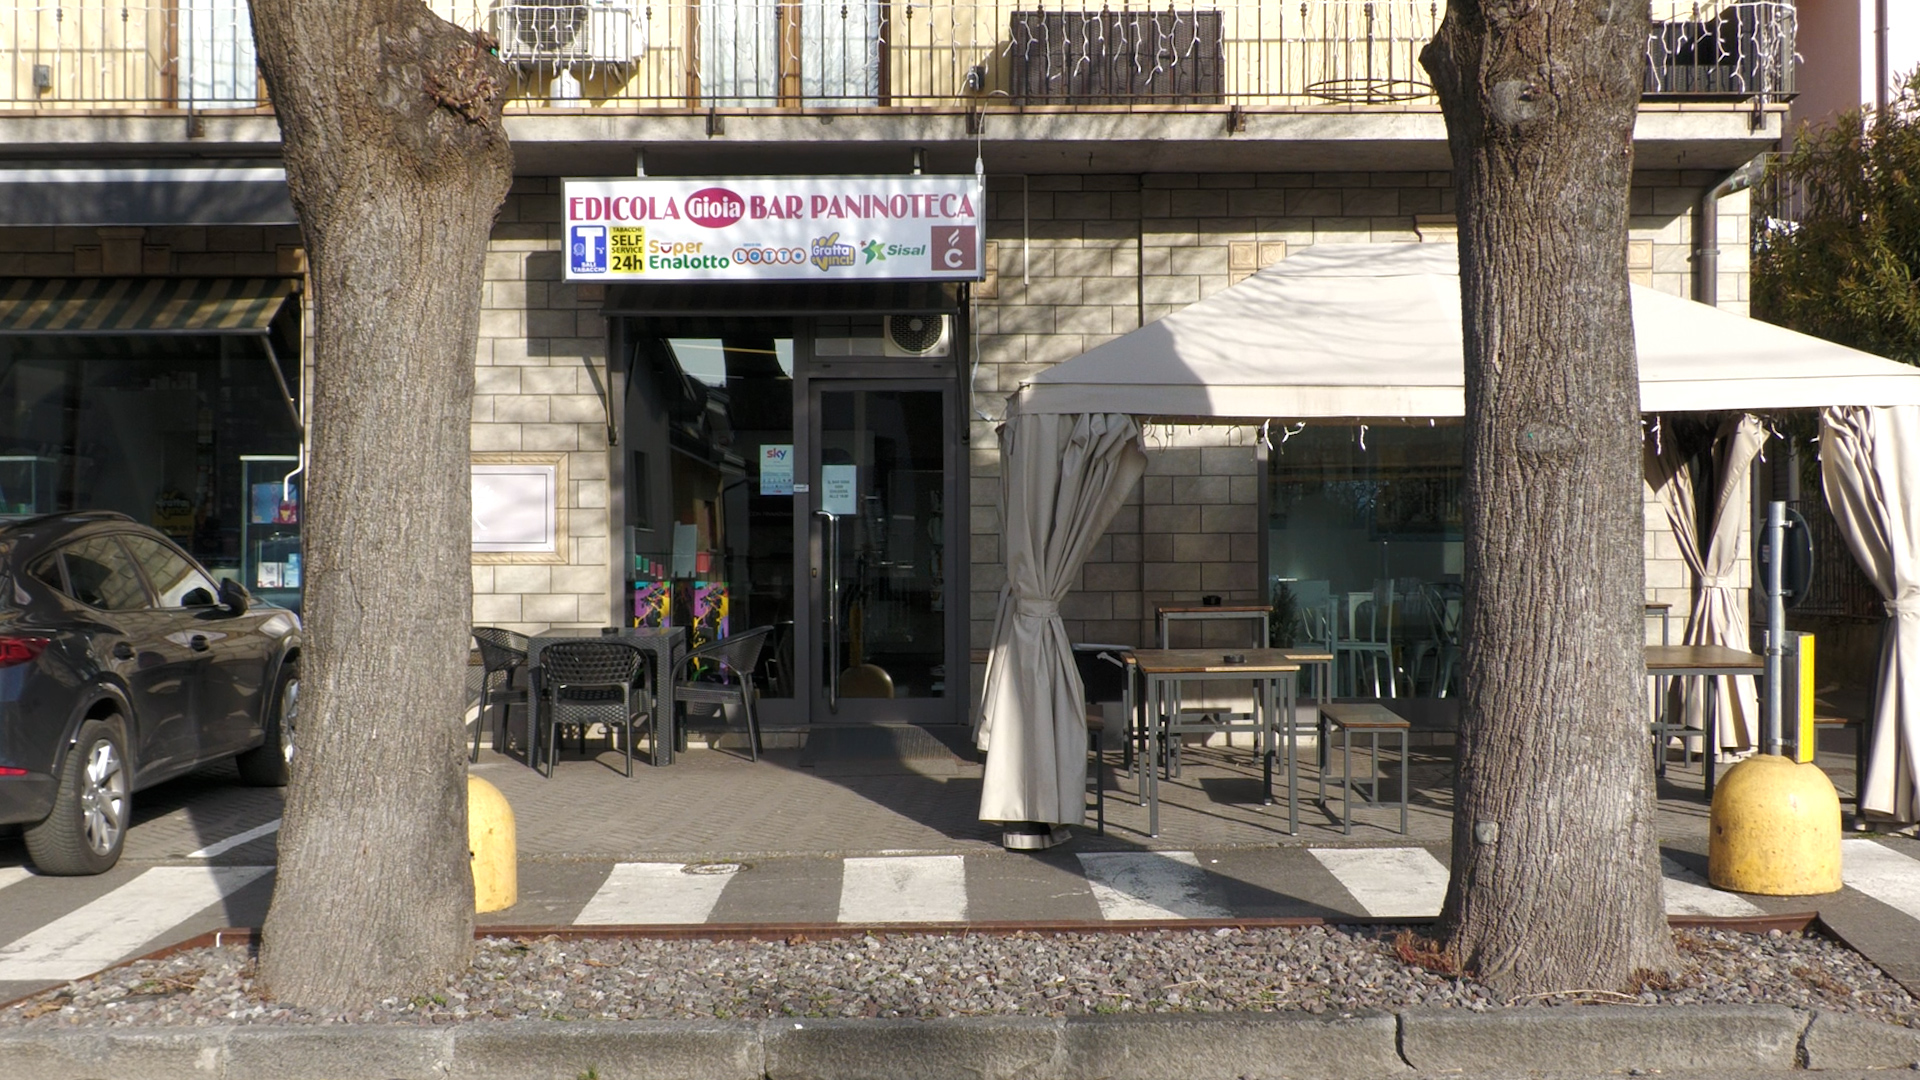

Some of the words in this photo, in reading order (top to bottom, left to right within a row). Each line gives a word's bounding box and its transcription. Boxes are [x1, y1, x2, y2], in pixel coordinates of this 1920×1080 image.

[570, 196, 680, 221] EDICOLA
[688, 196, 741, 219] Gioia
[750, 195, 803, 219] BAR
[811, 194, 975, 219] PANINOTECA
[576, 227, 604, 262] T
[611, 235, 643, 246] SELF
[649, 240, 703, 257] Super
[813, 245, 850, 255] Gratta
[887, 245, 926, 256] Sisal
[612, 255, 643, 270] 24h
[649, 254, 730, 269] Enalotto
[734, 249, 804, 263] LOTTO
[766, 448, 787, 460] sky
